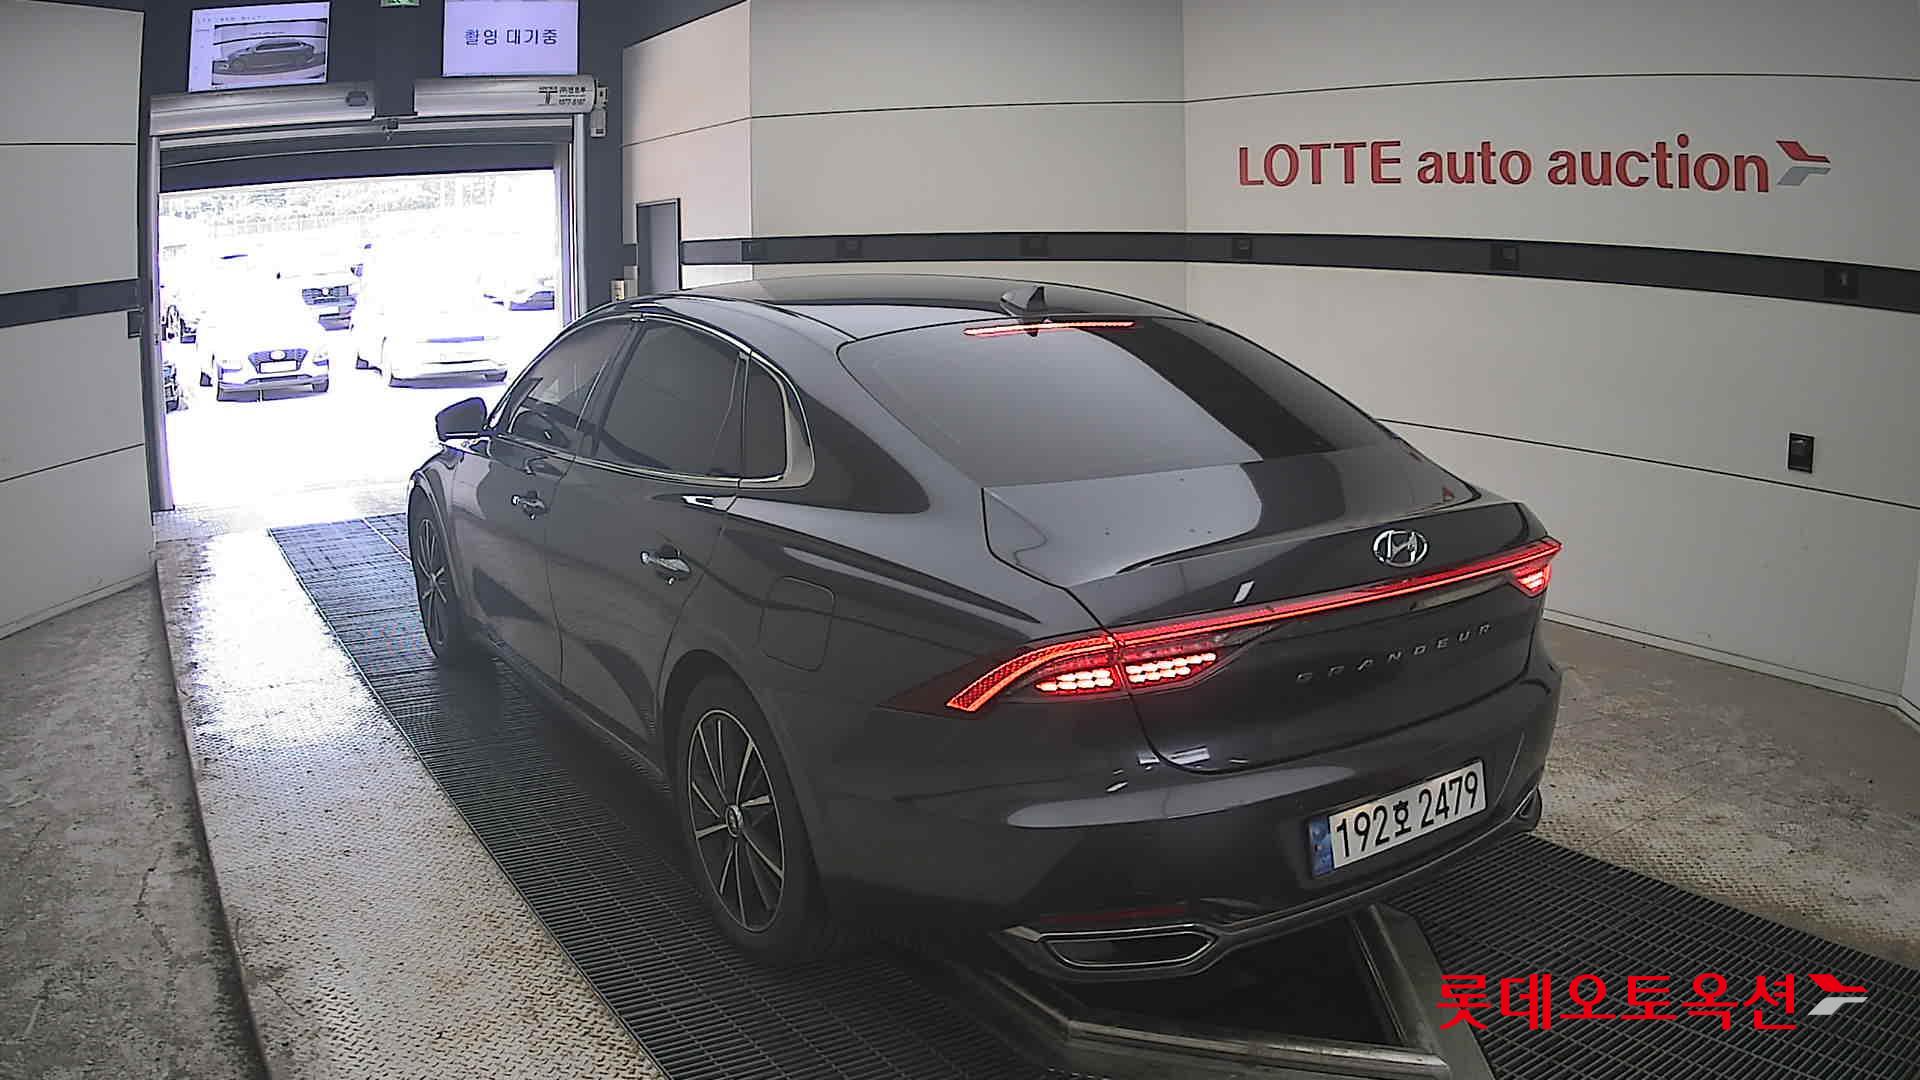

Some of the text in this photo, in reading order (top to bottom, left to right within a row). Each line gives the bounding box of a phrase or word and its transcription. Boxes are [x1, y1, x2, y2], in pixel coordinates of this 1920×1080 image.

[506, 29, 557, 45] 대기중
[1238, 133, 1770, 193] LOTTE auto auction
[1296, 623, 1491, 681] GRANDEUR
[1418, 771, 1478, 829] 2479
